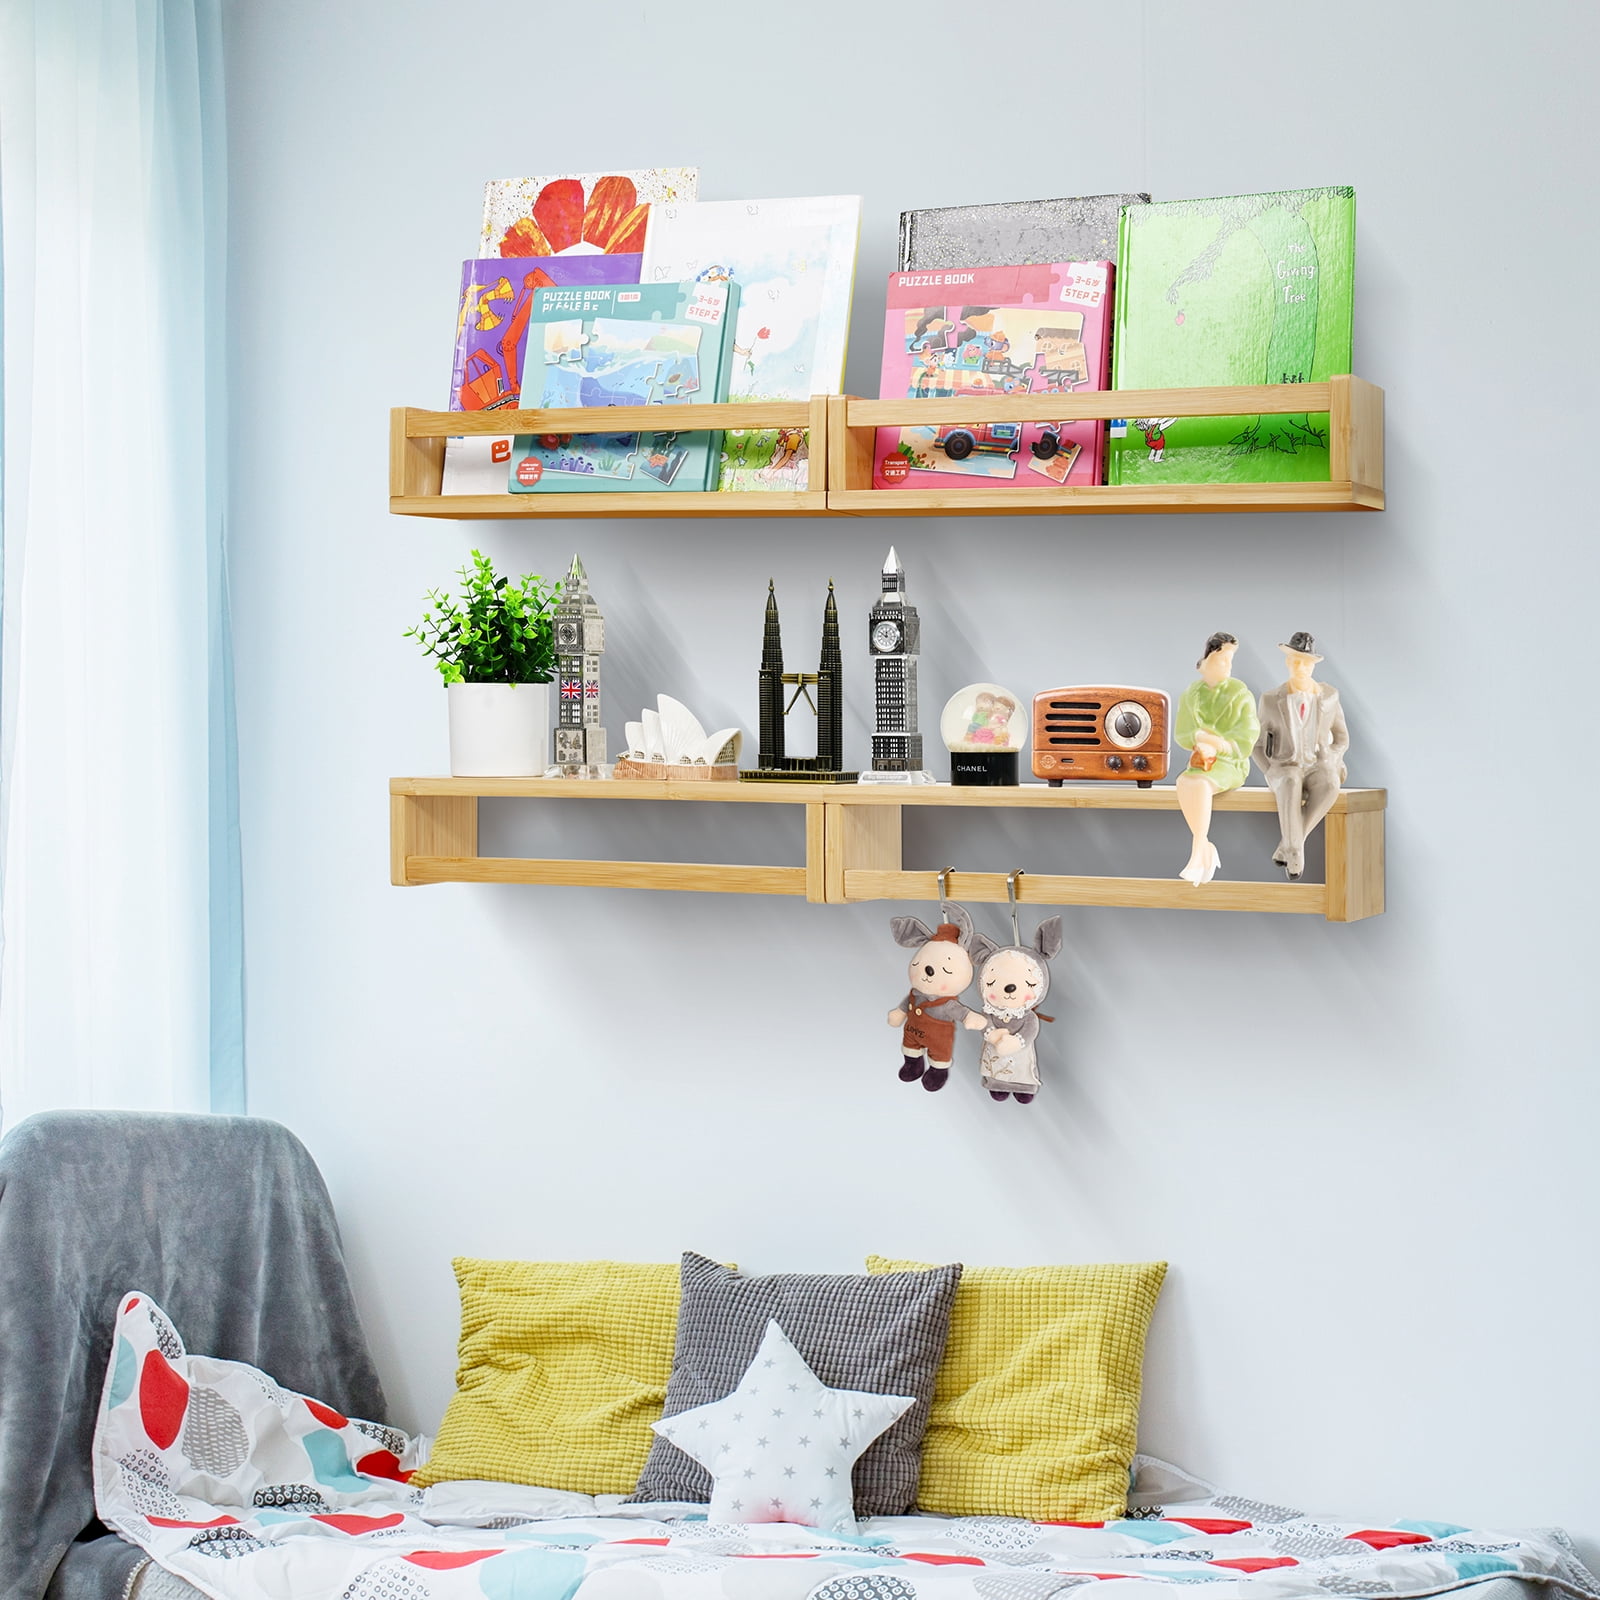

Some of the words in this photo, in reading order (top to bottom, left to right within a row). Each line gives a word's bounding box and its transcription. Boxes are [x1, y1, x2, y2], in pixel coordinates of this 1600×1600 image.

[1277, 260, 1315, 280] Giving
[898, 274, 943, 288] PUZZLE
[944, 272, 976, 285] BOOK
[542, 291, 583, 302] PUZZLE
[583, 290, 612, 301] BOOK
[1064, 288, 1090, 300] STEP
[1090, 291, 1101, 303] 2
[1282, 284, 1307, 304] Tree
[688, 306, 711, 318] STEP
[711, 310, 721, 321] 2
[906, 1025, 926, 1038] LOVE
